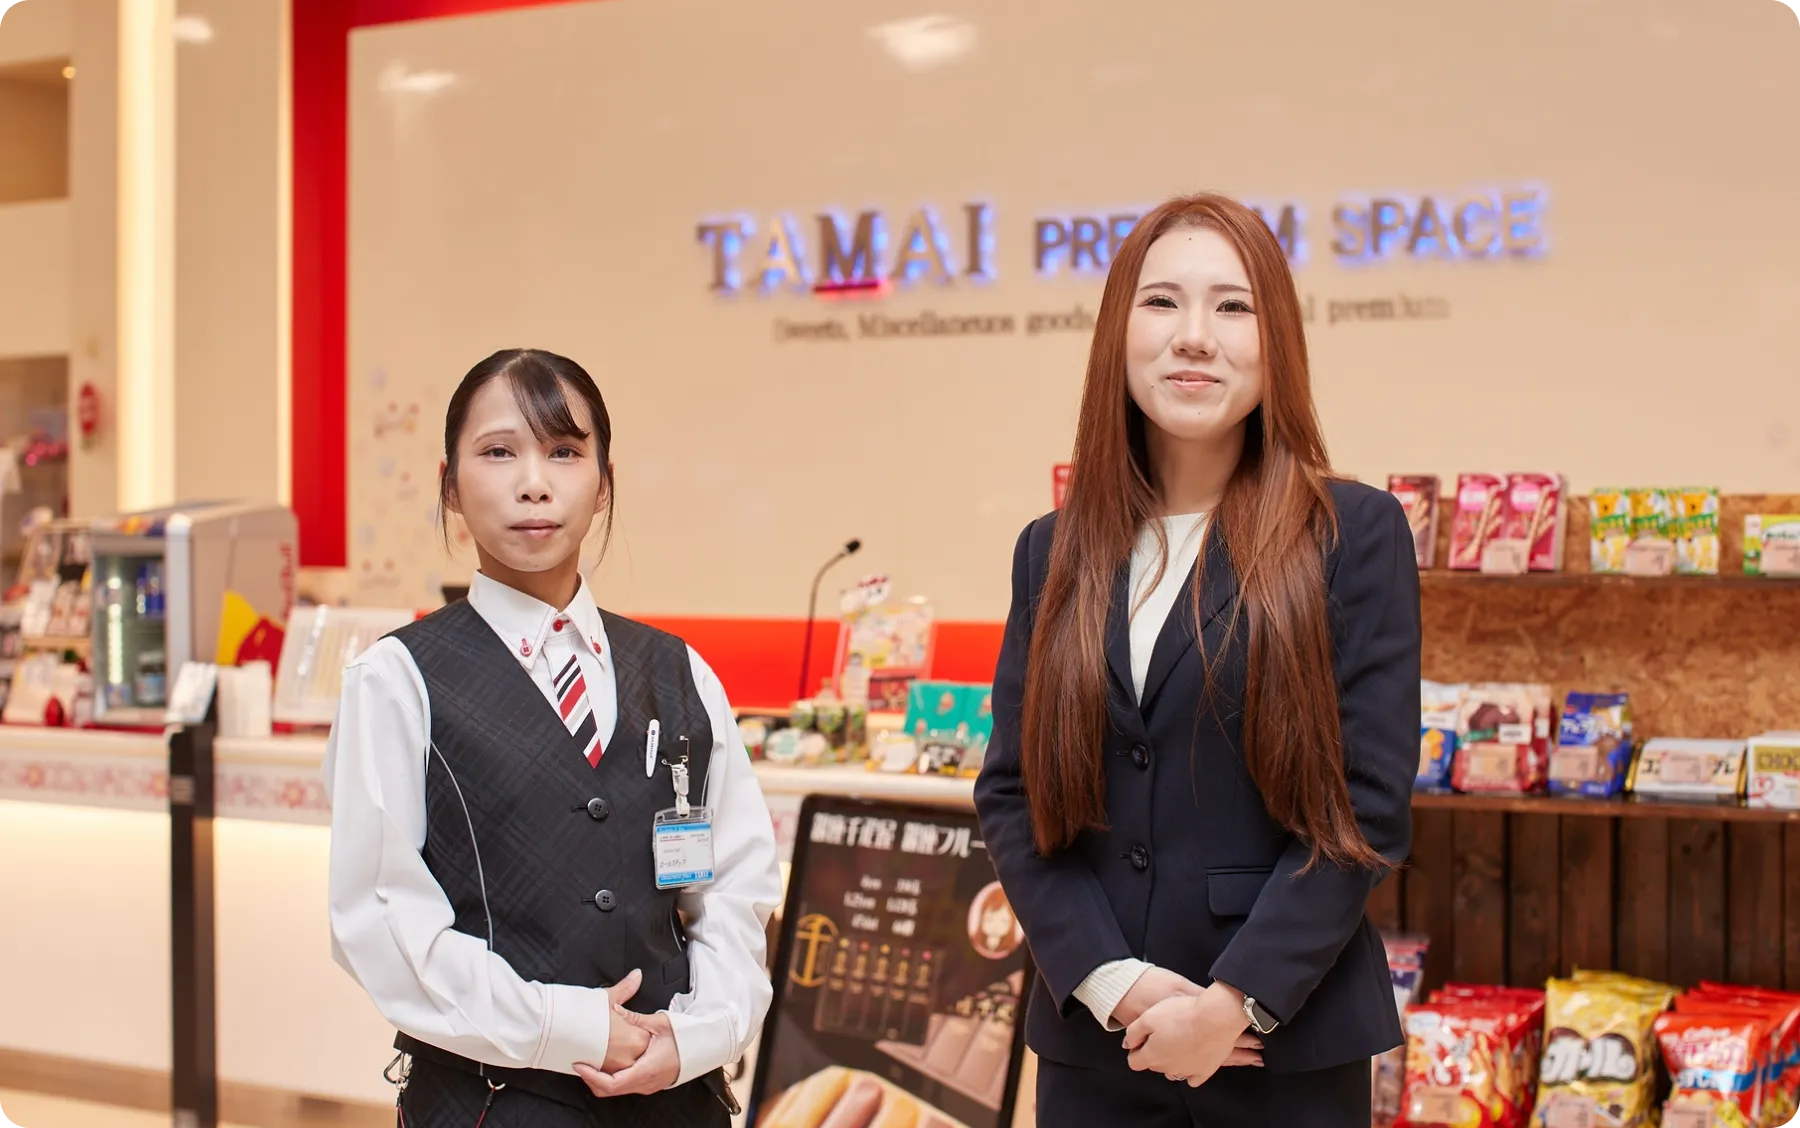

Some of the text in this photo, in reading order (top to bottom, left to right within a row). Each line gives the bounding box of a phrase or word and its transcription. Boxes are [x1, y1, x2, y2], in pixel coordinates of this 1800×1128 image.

[697, 190, 1541, 291] TAMAI PREM SPACE
[1541, 1035, 1636, 1084] カール
